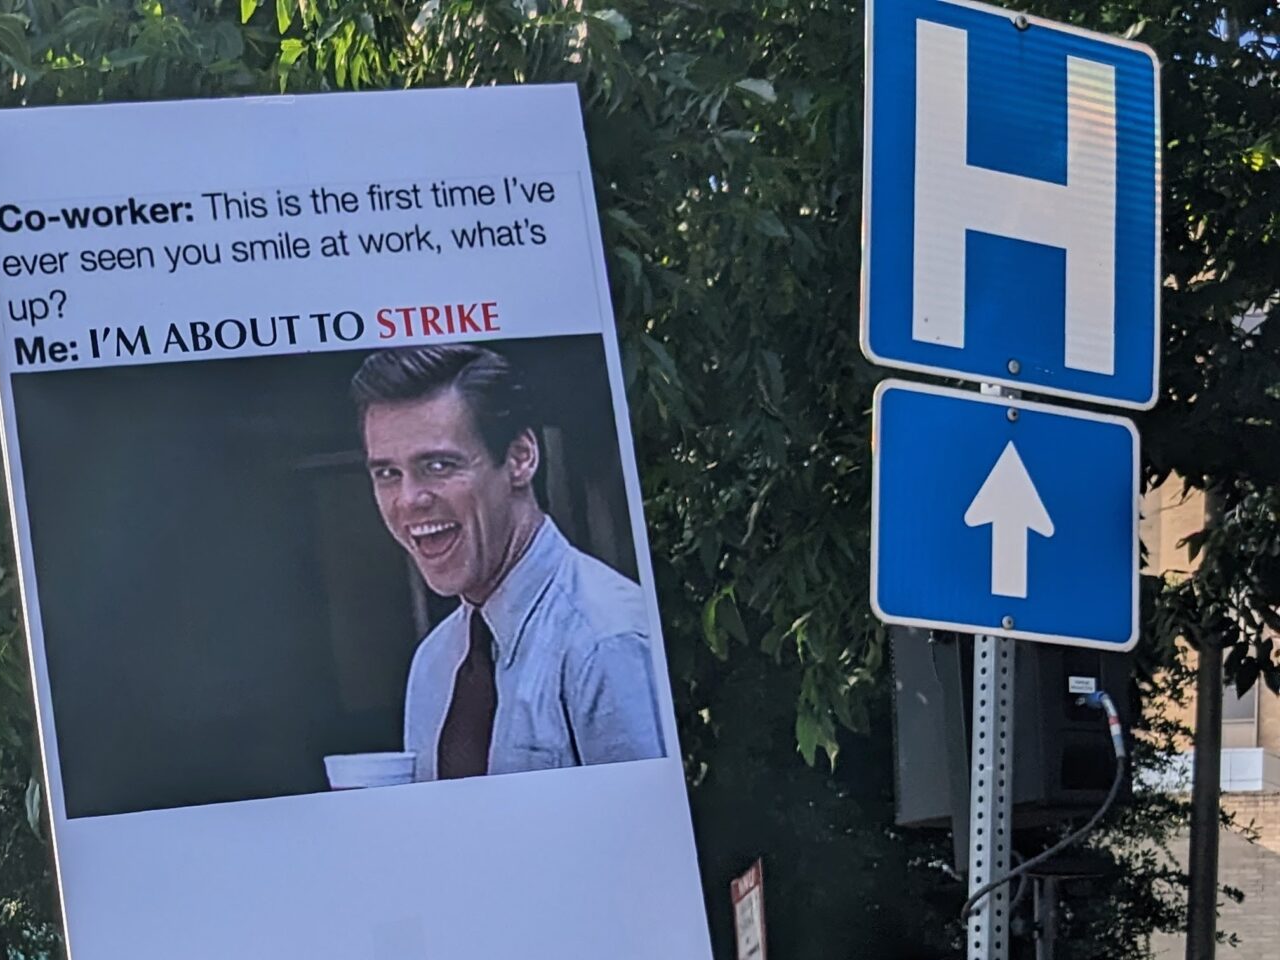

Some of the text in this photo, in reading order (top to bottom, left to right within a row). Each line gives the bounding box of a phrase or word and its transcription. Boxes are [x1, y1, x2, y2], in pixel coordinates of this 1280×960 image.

[202, 189, 268, 221] This
[277, 190, 301, 217] is
[310, 186, 358, 215] the
[367, 181, 423, 211] first
[430, 178, 495, 207] time
[913, 18, 1115, 375] H
[2, 250, 69, 277] ever
[80, 245, 155, 272] seen
[168, 241, 221, 273] you
[231, 231, 310, 263] smile
[321, 231, 349, 257] at
[358, 226, 441, 255] work,
[9, 290, 68, 326] up?
[15, 338, 79, 365] Me:
[163, 314, 301, 355] ABOUT
[309, 310, 365, 342] TO
[376, 302, 502, 338] STRIKE
